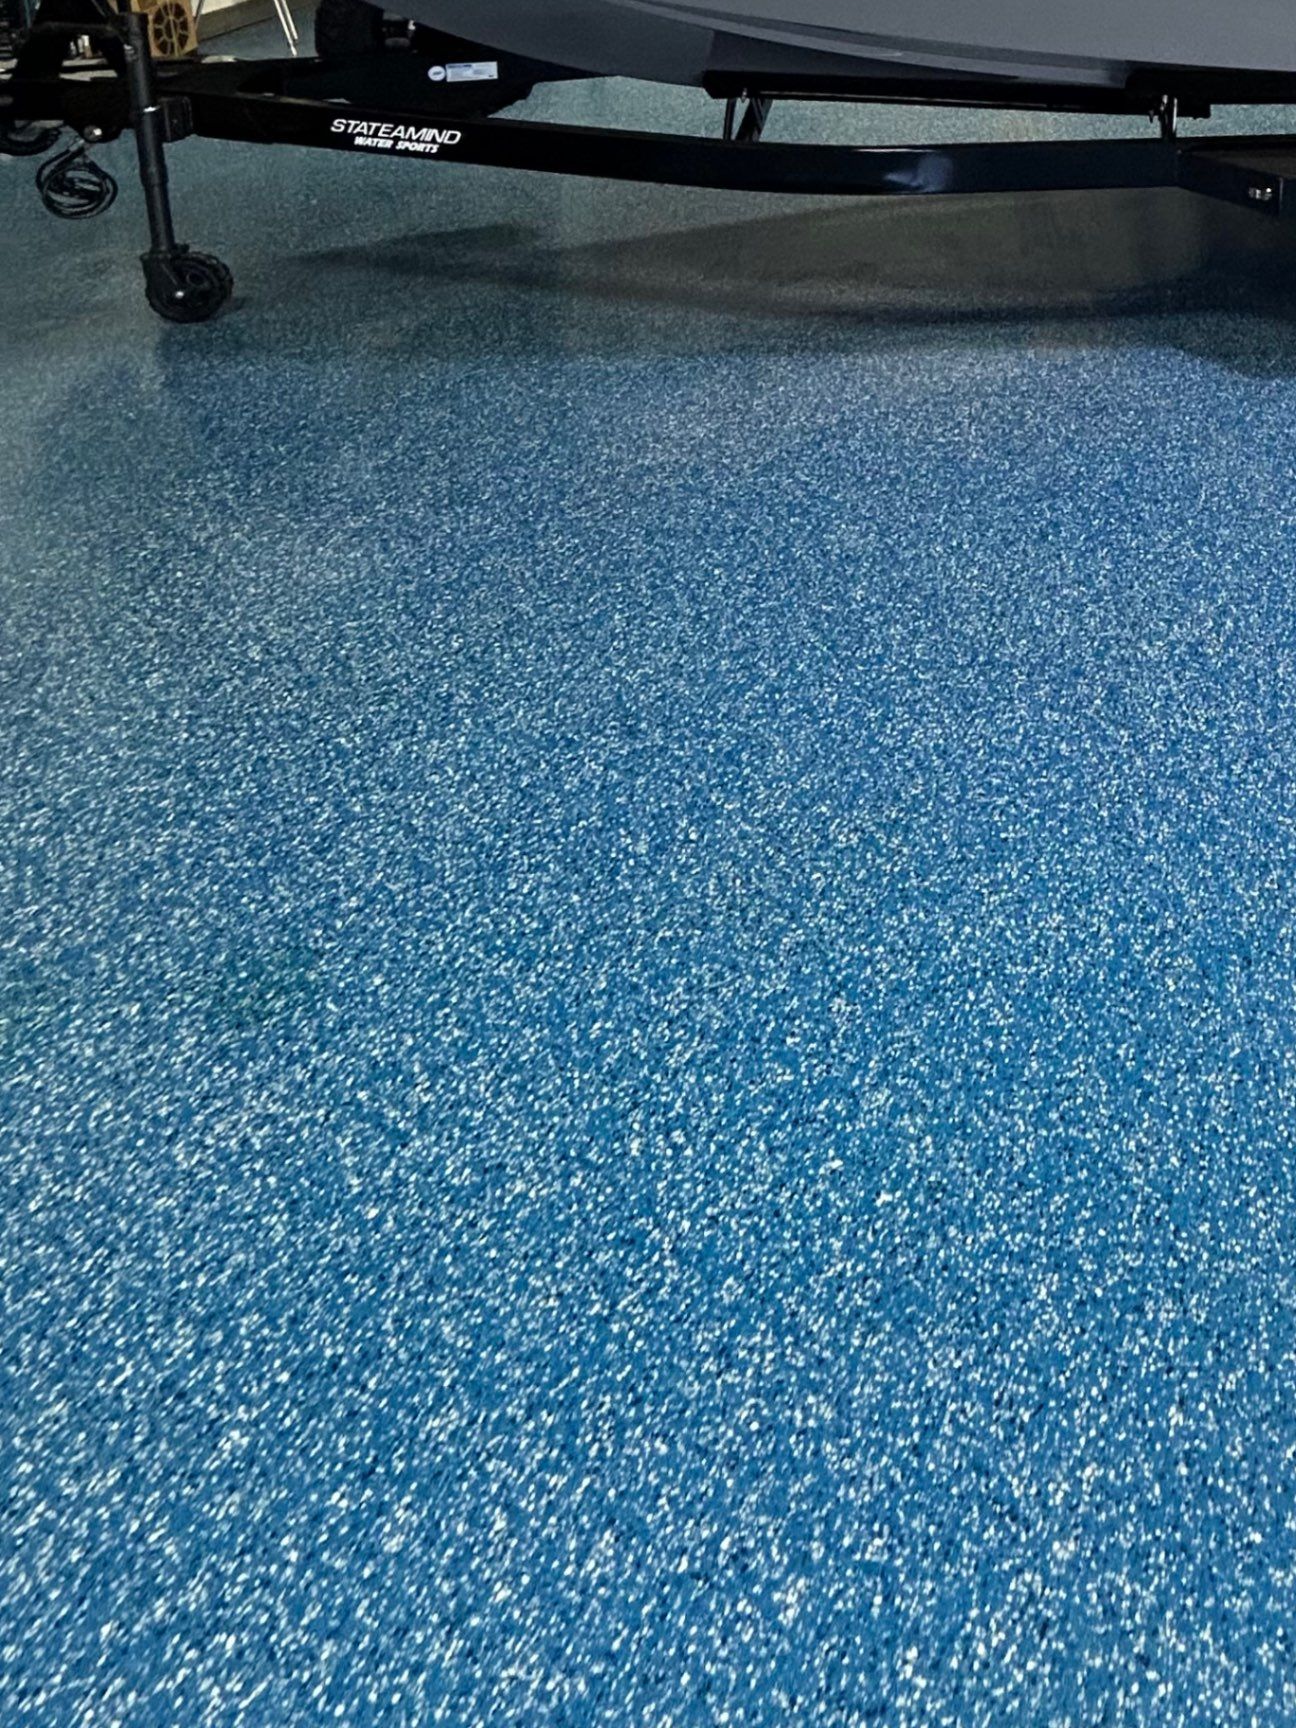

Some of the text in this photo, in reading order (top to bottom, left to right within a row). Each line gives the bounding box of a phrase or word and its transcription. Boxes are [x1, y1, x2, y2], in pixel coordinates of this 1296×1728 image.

[330, 118, 462, 145] STATEAMIND
[353, 136, 440, 154] WATER SPORTS
